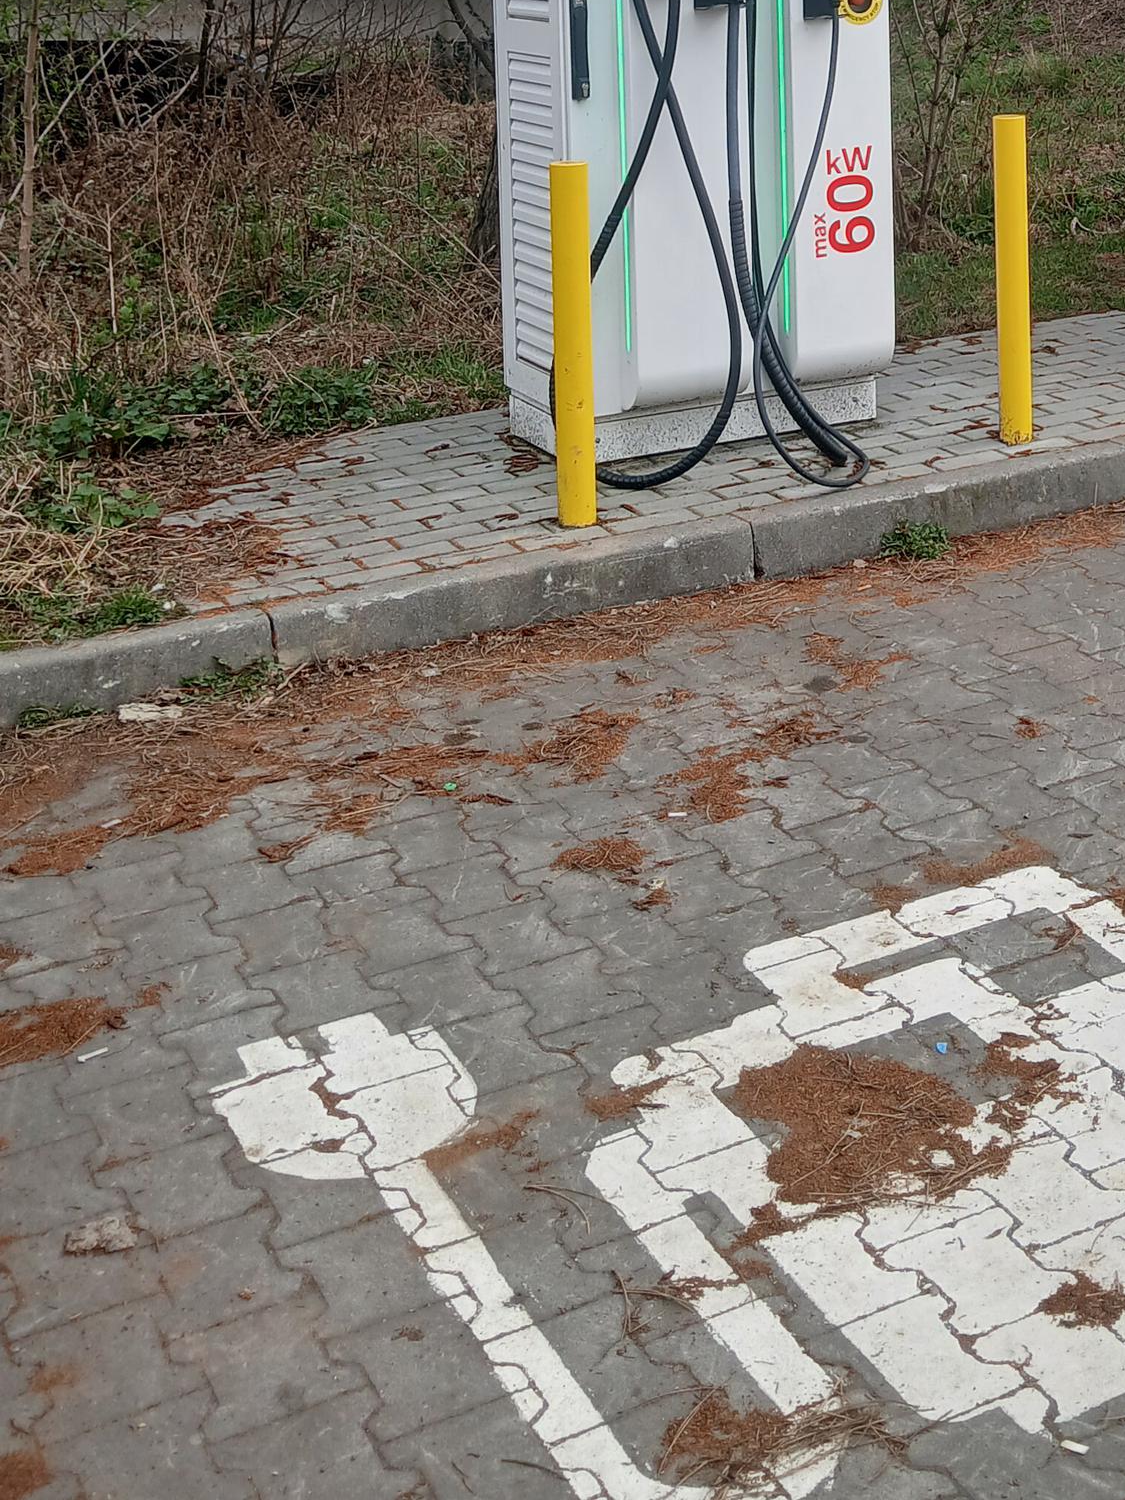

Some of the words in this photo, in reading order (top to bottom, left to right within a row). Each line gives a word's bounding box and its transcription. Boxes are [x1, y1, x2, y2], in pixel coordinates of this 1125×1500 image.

[826, 145, 873, 175] kW
[814, 211, 828, 259] max
[826, 174, 876, 254] 60
